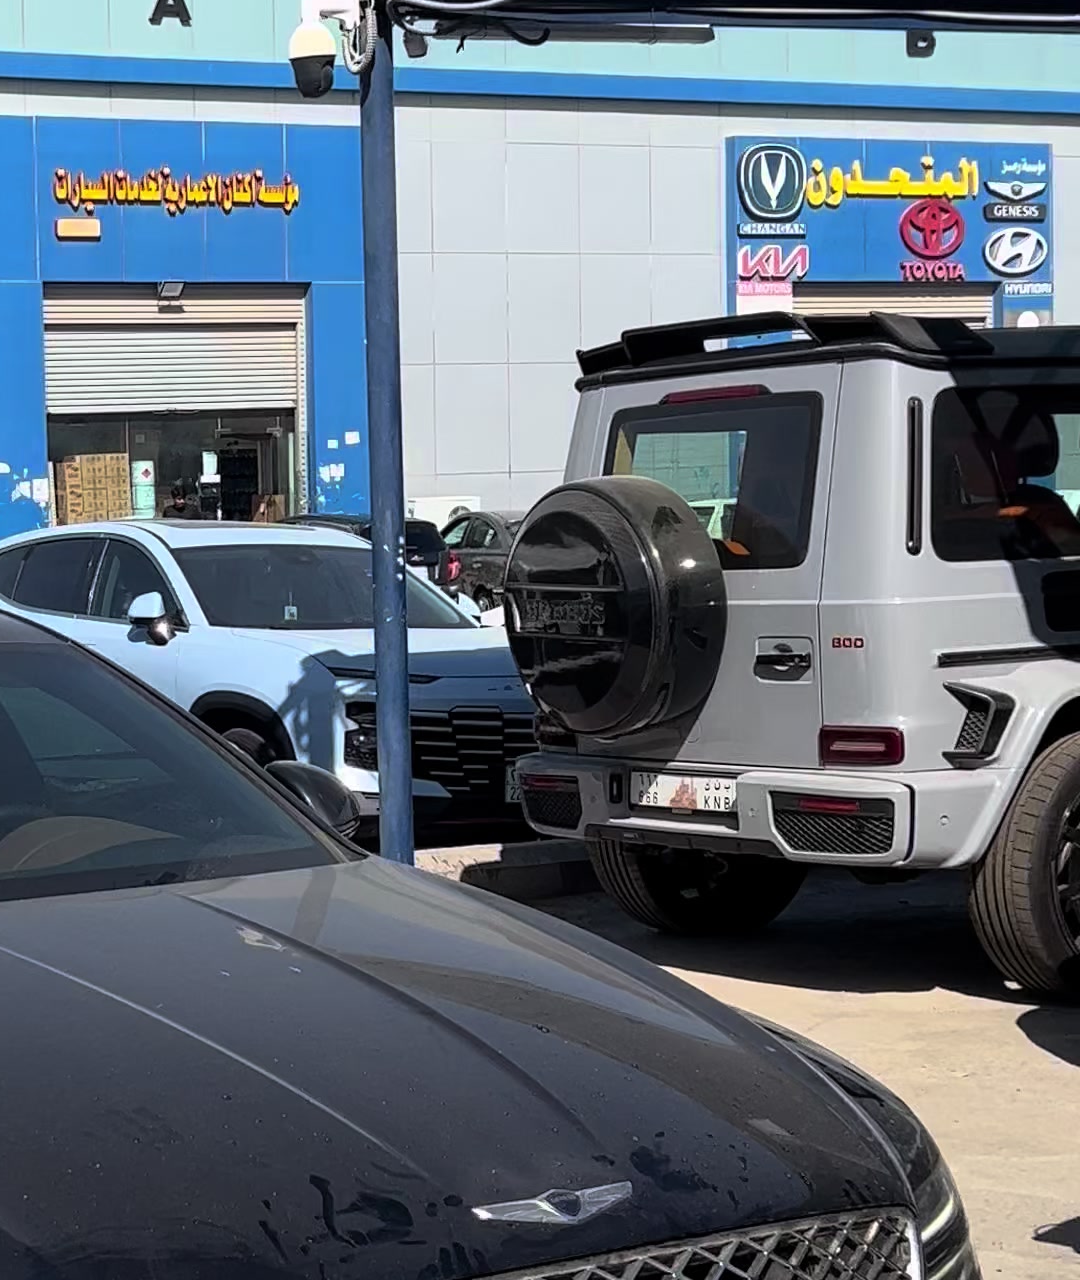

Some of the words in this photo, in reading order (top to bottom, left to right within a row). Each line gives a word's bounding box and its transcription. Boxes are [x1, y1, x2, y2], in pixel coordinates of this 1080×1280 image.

[54, 168, 114, 214] السيارات
[256, 169, 300, 213] مؤسسة
[806, 156, 980, 208] المتحدون
[993, 204, 1040, 217] GENESIS
[740, 223, 806, 235] CHANGAN
[902, 260, 966, 281] TOYOTA
